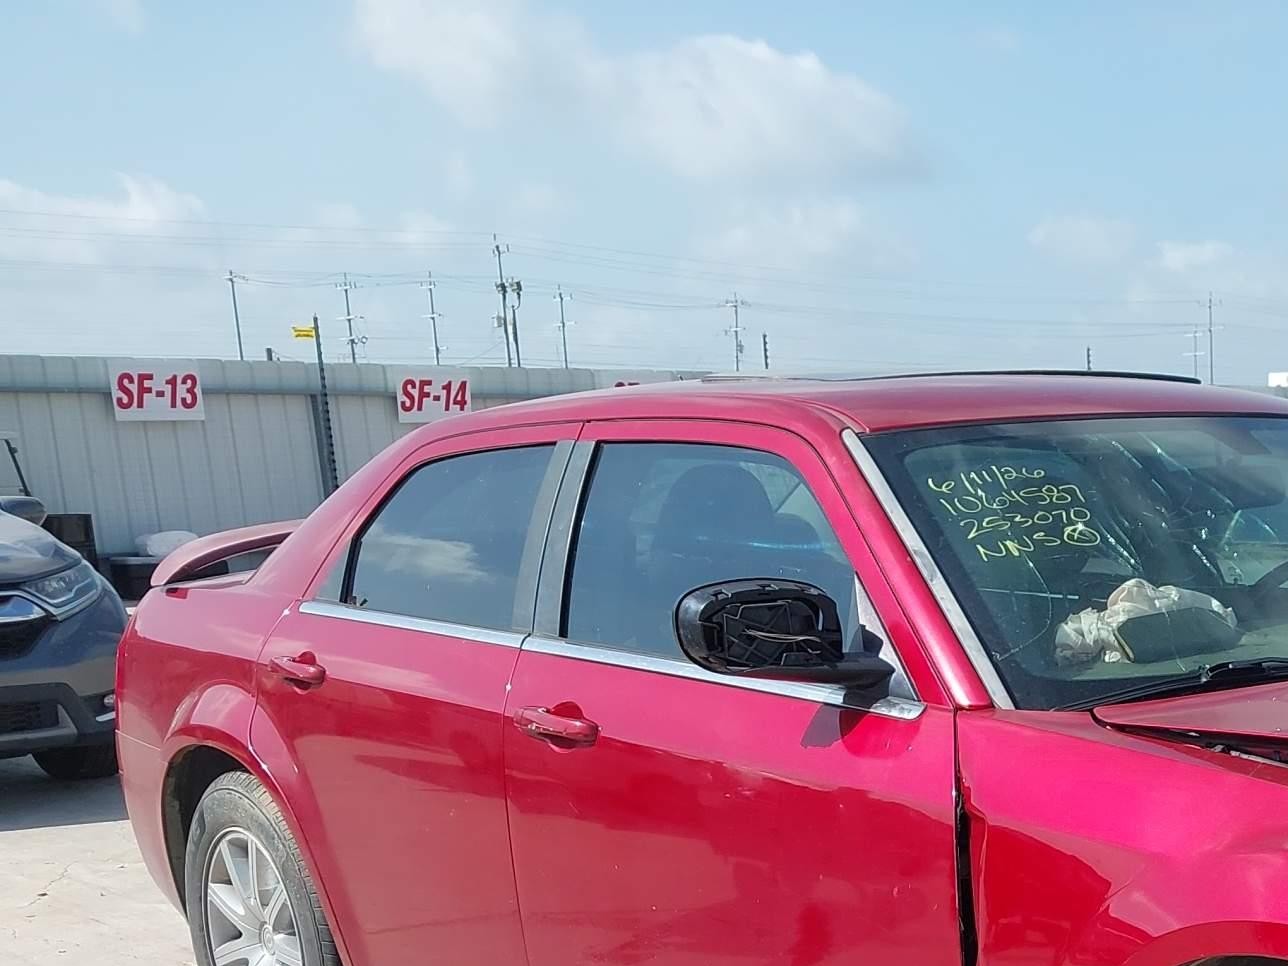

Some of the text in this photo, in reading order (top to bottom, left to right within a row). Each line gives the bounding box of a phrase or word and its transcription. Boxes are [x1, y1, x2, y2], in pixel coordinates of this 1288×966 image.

[116, 372, 198, 410] SF-13
[400, 378, 468, 412] SF-14
[928, 465, 1045, 494] 6/11/26
[960, 507, 1091, 540] 253070
